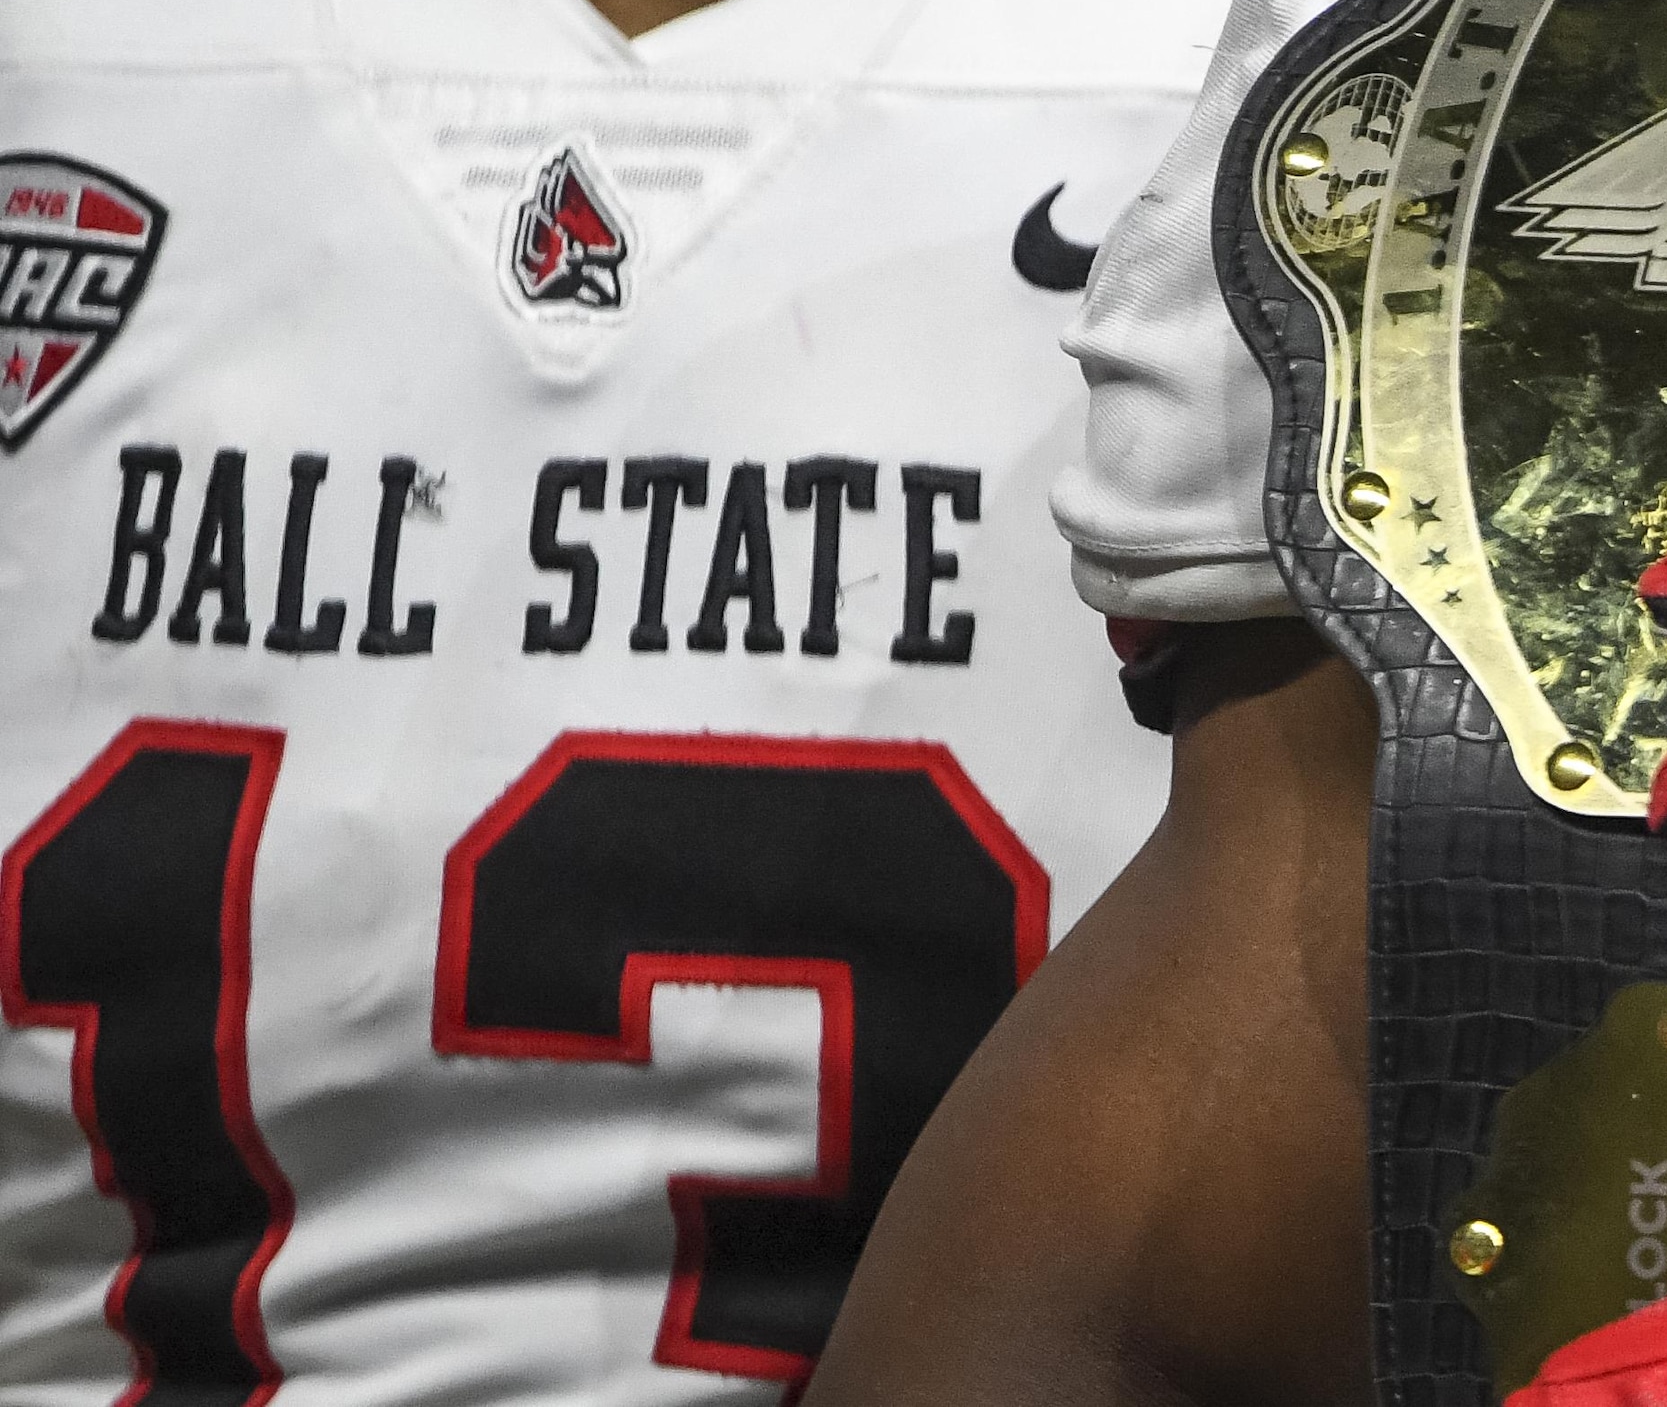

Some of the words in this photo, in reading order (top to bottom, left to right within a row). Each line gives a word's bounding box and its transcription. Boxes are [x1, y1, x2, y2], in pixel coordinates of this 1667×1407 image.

[0, 246, 138, 324] AC
[92, 444, 437, 656] BALL
[522, 456, 982, 664] STATE
[0, 716, 1050, 1407] 13
